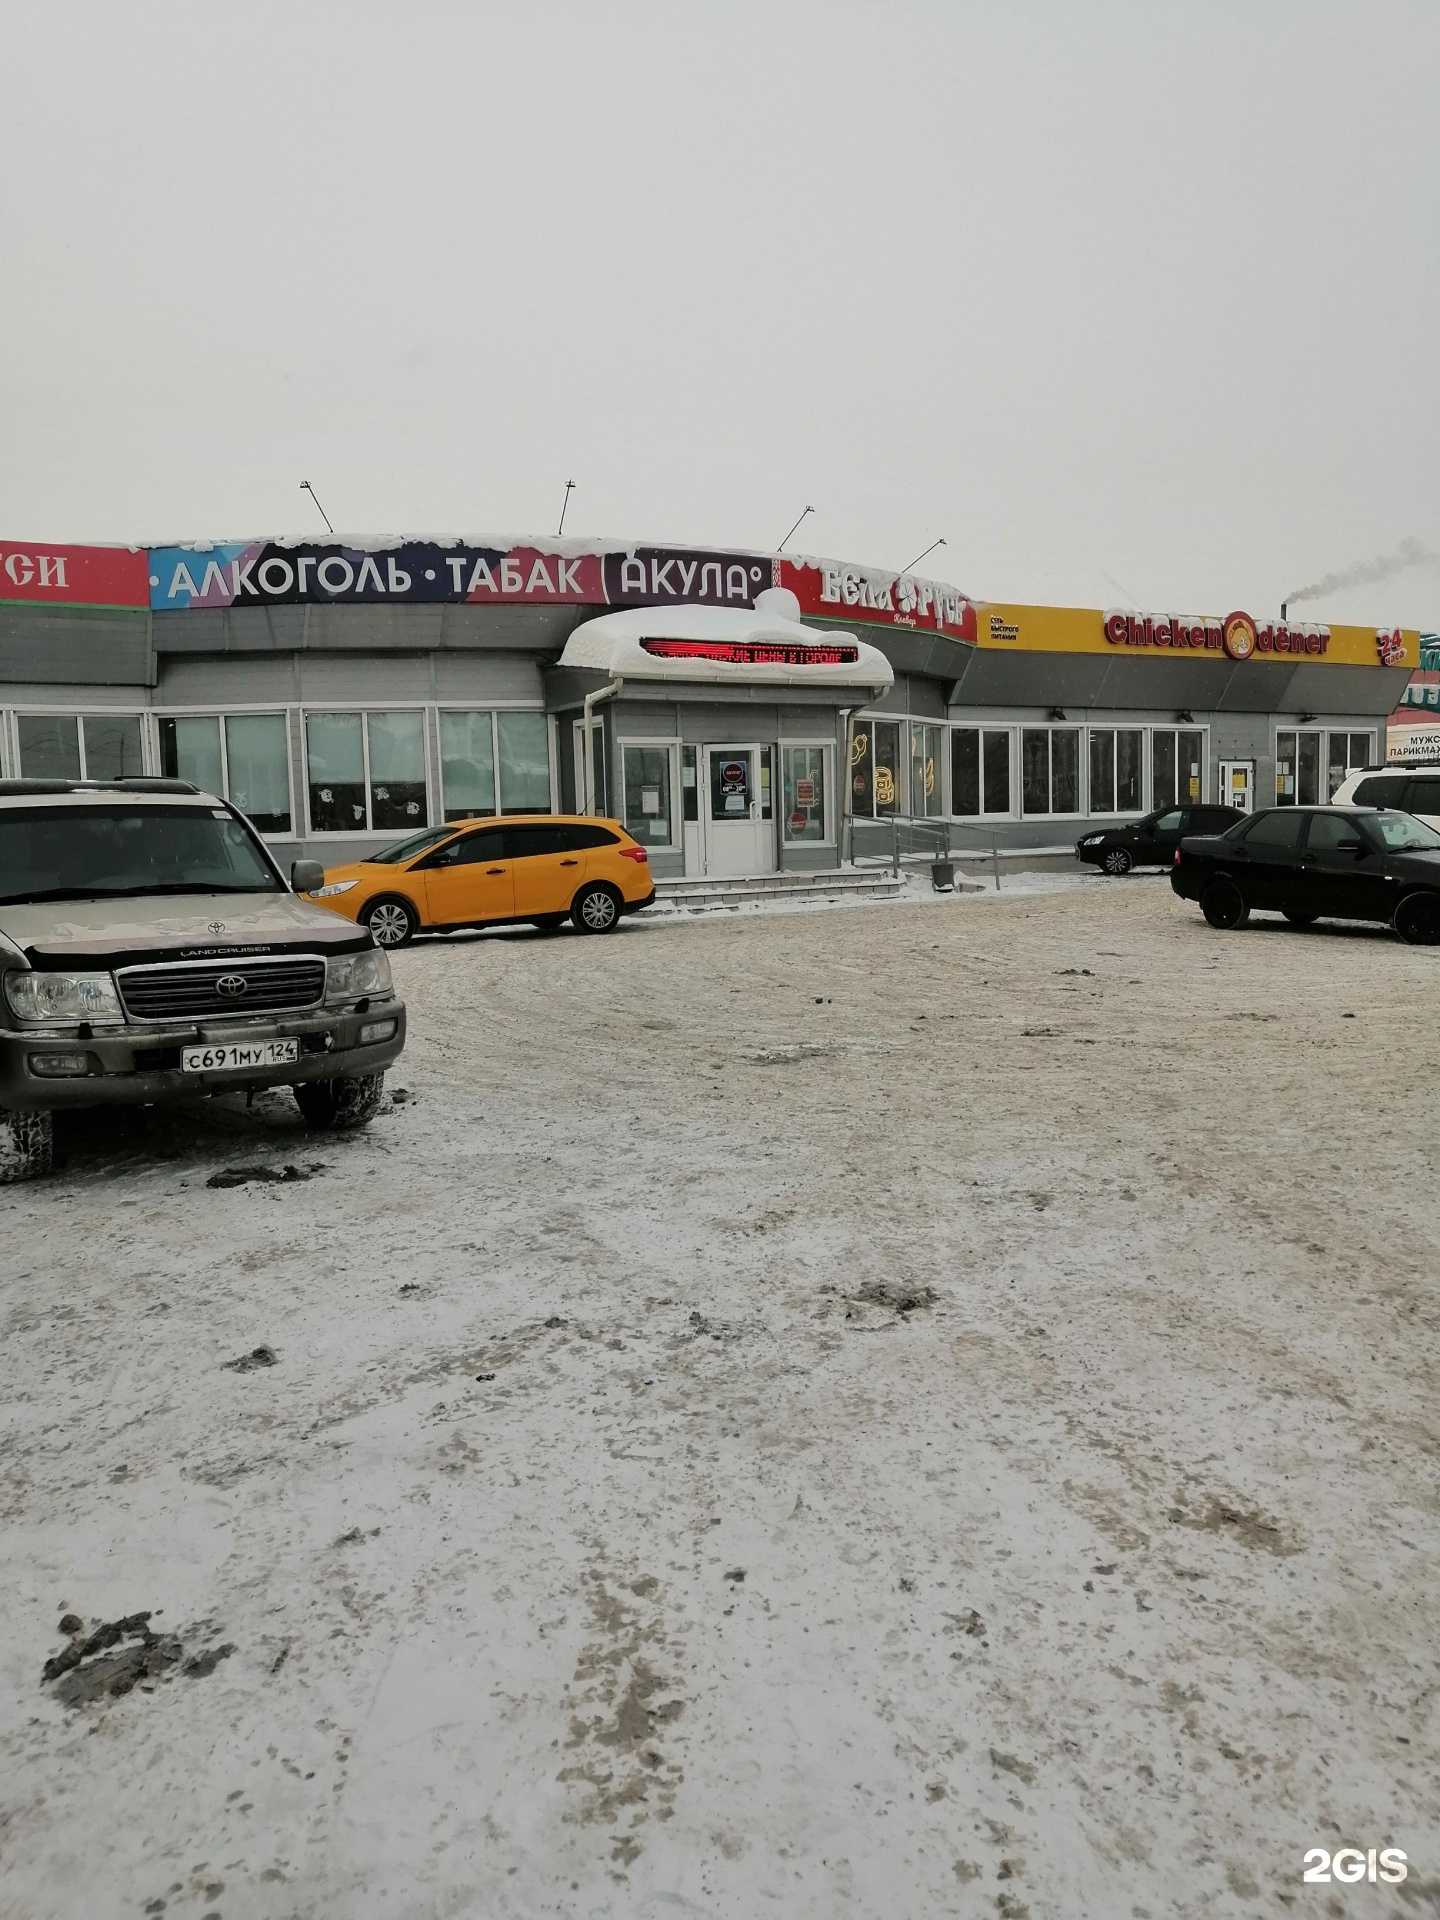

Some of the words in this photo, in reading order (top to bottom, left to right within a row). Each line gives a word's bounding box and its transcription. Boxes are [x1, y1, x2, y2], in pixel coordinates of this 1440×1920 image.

[0, 553, 70, 588] СИ
[167, 556, 412, 599] АЛКОГОЛЬ
[445, 558, 584, 594] ТАБАК
[1105, 614, 1223, 649] Chicken
[1379, 627, 1402, 656] 24
[1410, 735, 1440, 745] МУЖС
[180, 949, 217, 957] LAND
[217, 946, 271, 955] CRUISER
[267, 1042, 296, 1057] 124
